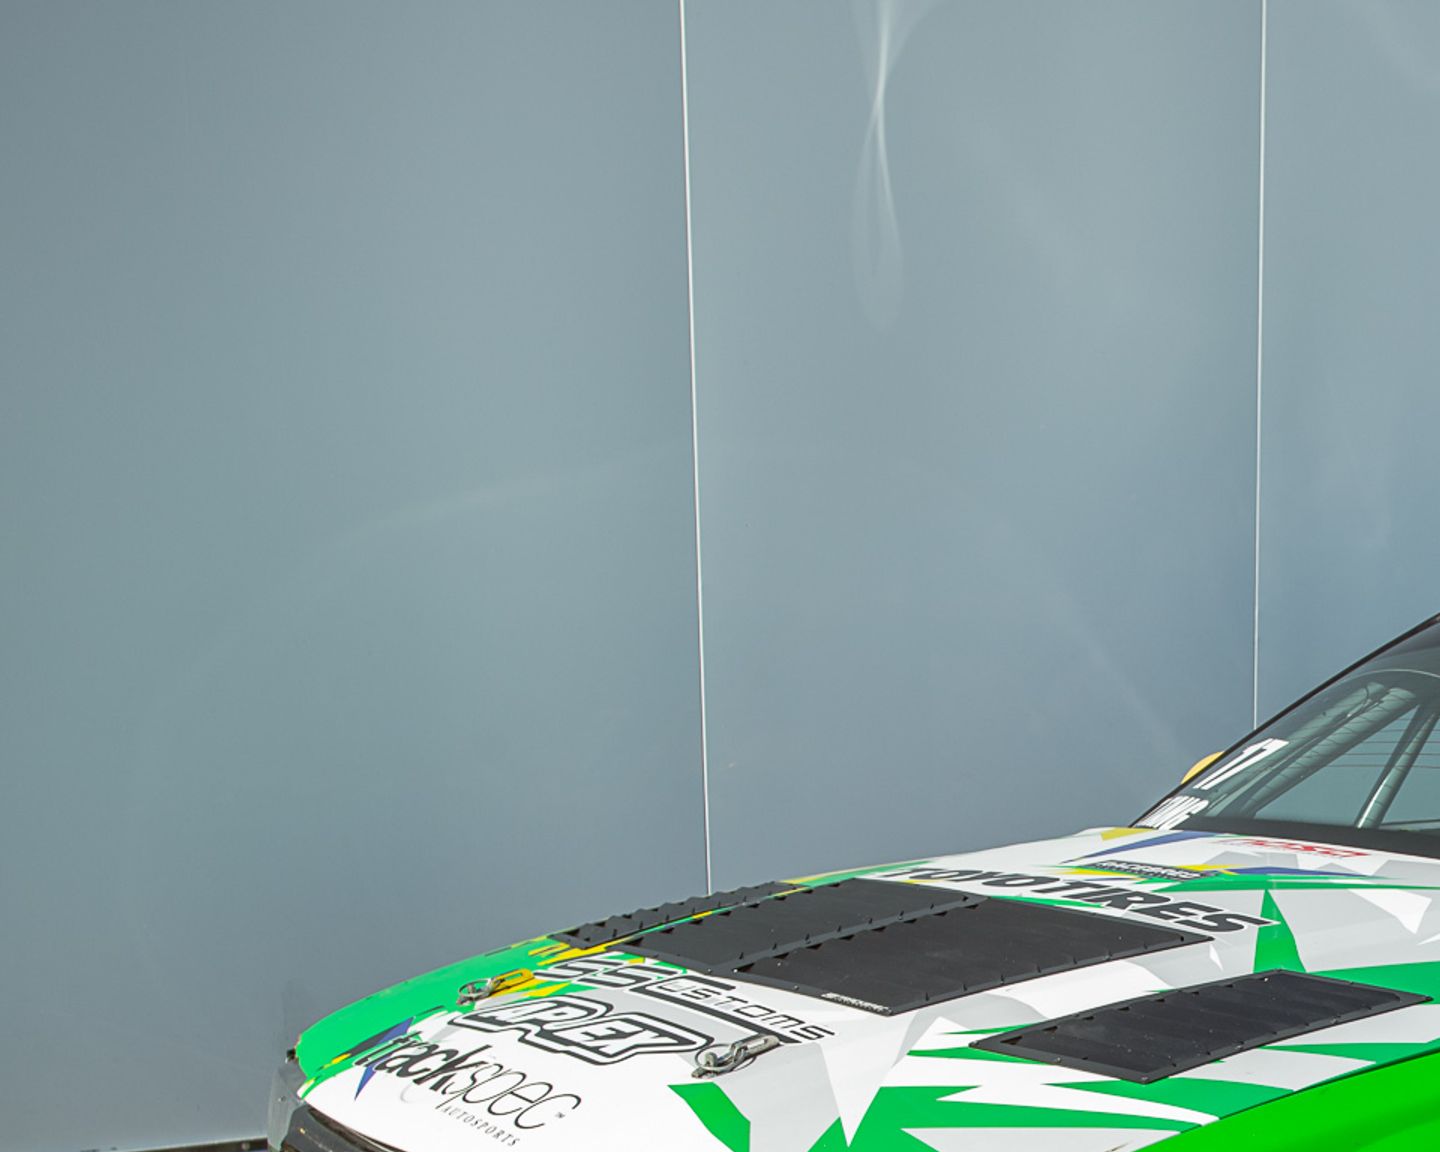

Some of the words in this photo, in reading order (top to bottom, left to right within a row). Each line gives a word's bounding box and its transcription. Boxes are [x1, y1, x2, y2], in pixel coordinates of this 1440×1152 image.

[1193, 738, 1289, 790] 17
[881, 868, 1060, 887] TOYO
[1031, 880, 1276, 932] TIRES
[458, 996, 708, 1060] APEX
[354, 1031, 582, 1129] trackspec
[443, 1107, 520, 1146] AUTOSPORTS
